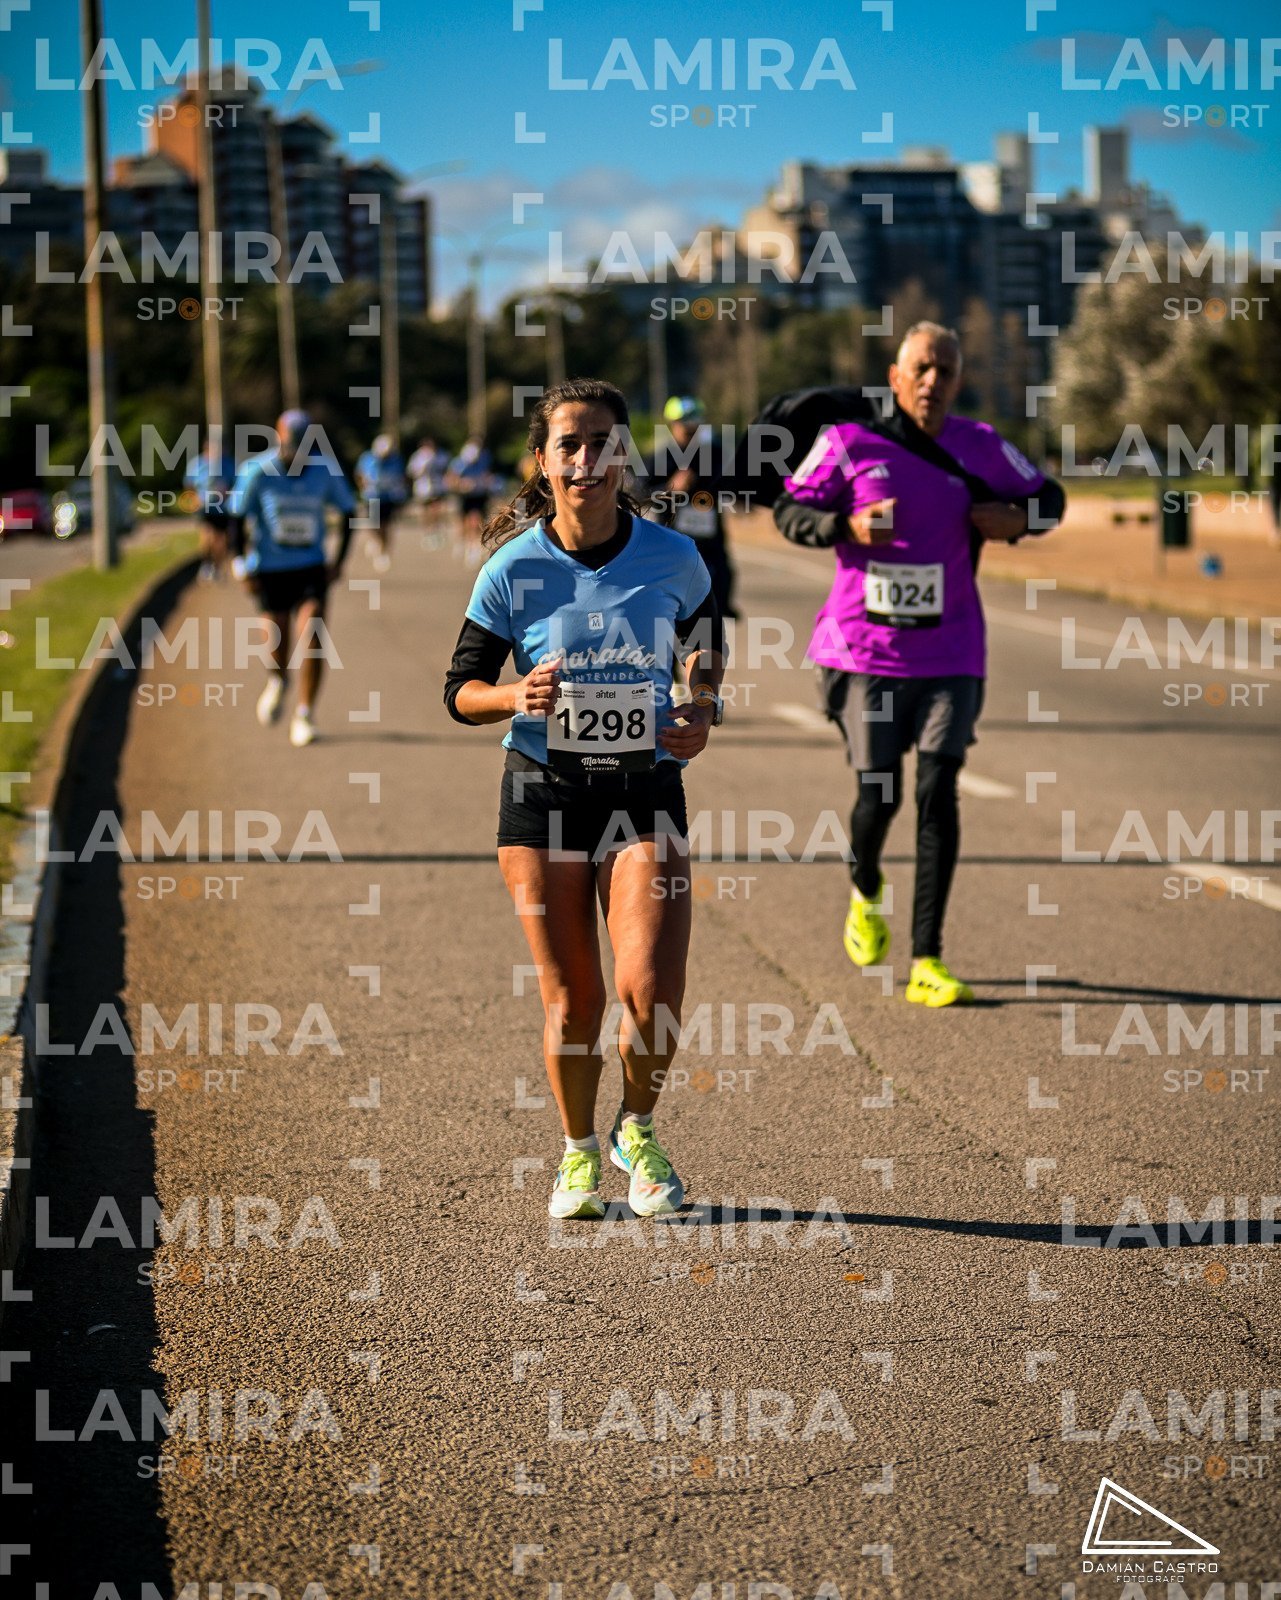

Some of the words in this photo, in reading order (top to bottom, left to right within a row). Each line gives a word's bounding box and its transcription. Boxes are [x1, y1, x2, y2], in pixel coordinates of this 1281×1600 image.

[874, 582, 936, 607] 1024
[565, 672, 646, 683] ONTEVIDEO
[595, 690, 616, 699] antel
[556, 708, 646, 742] 1298
[581, 756, 620, 766] Maratón
